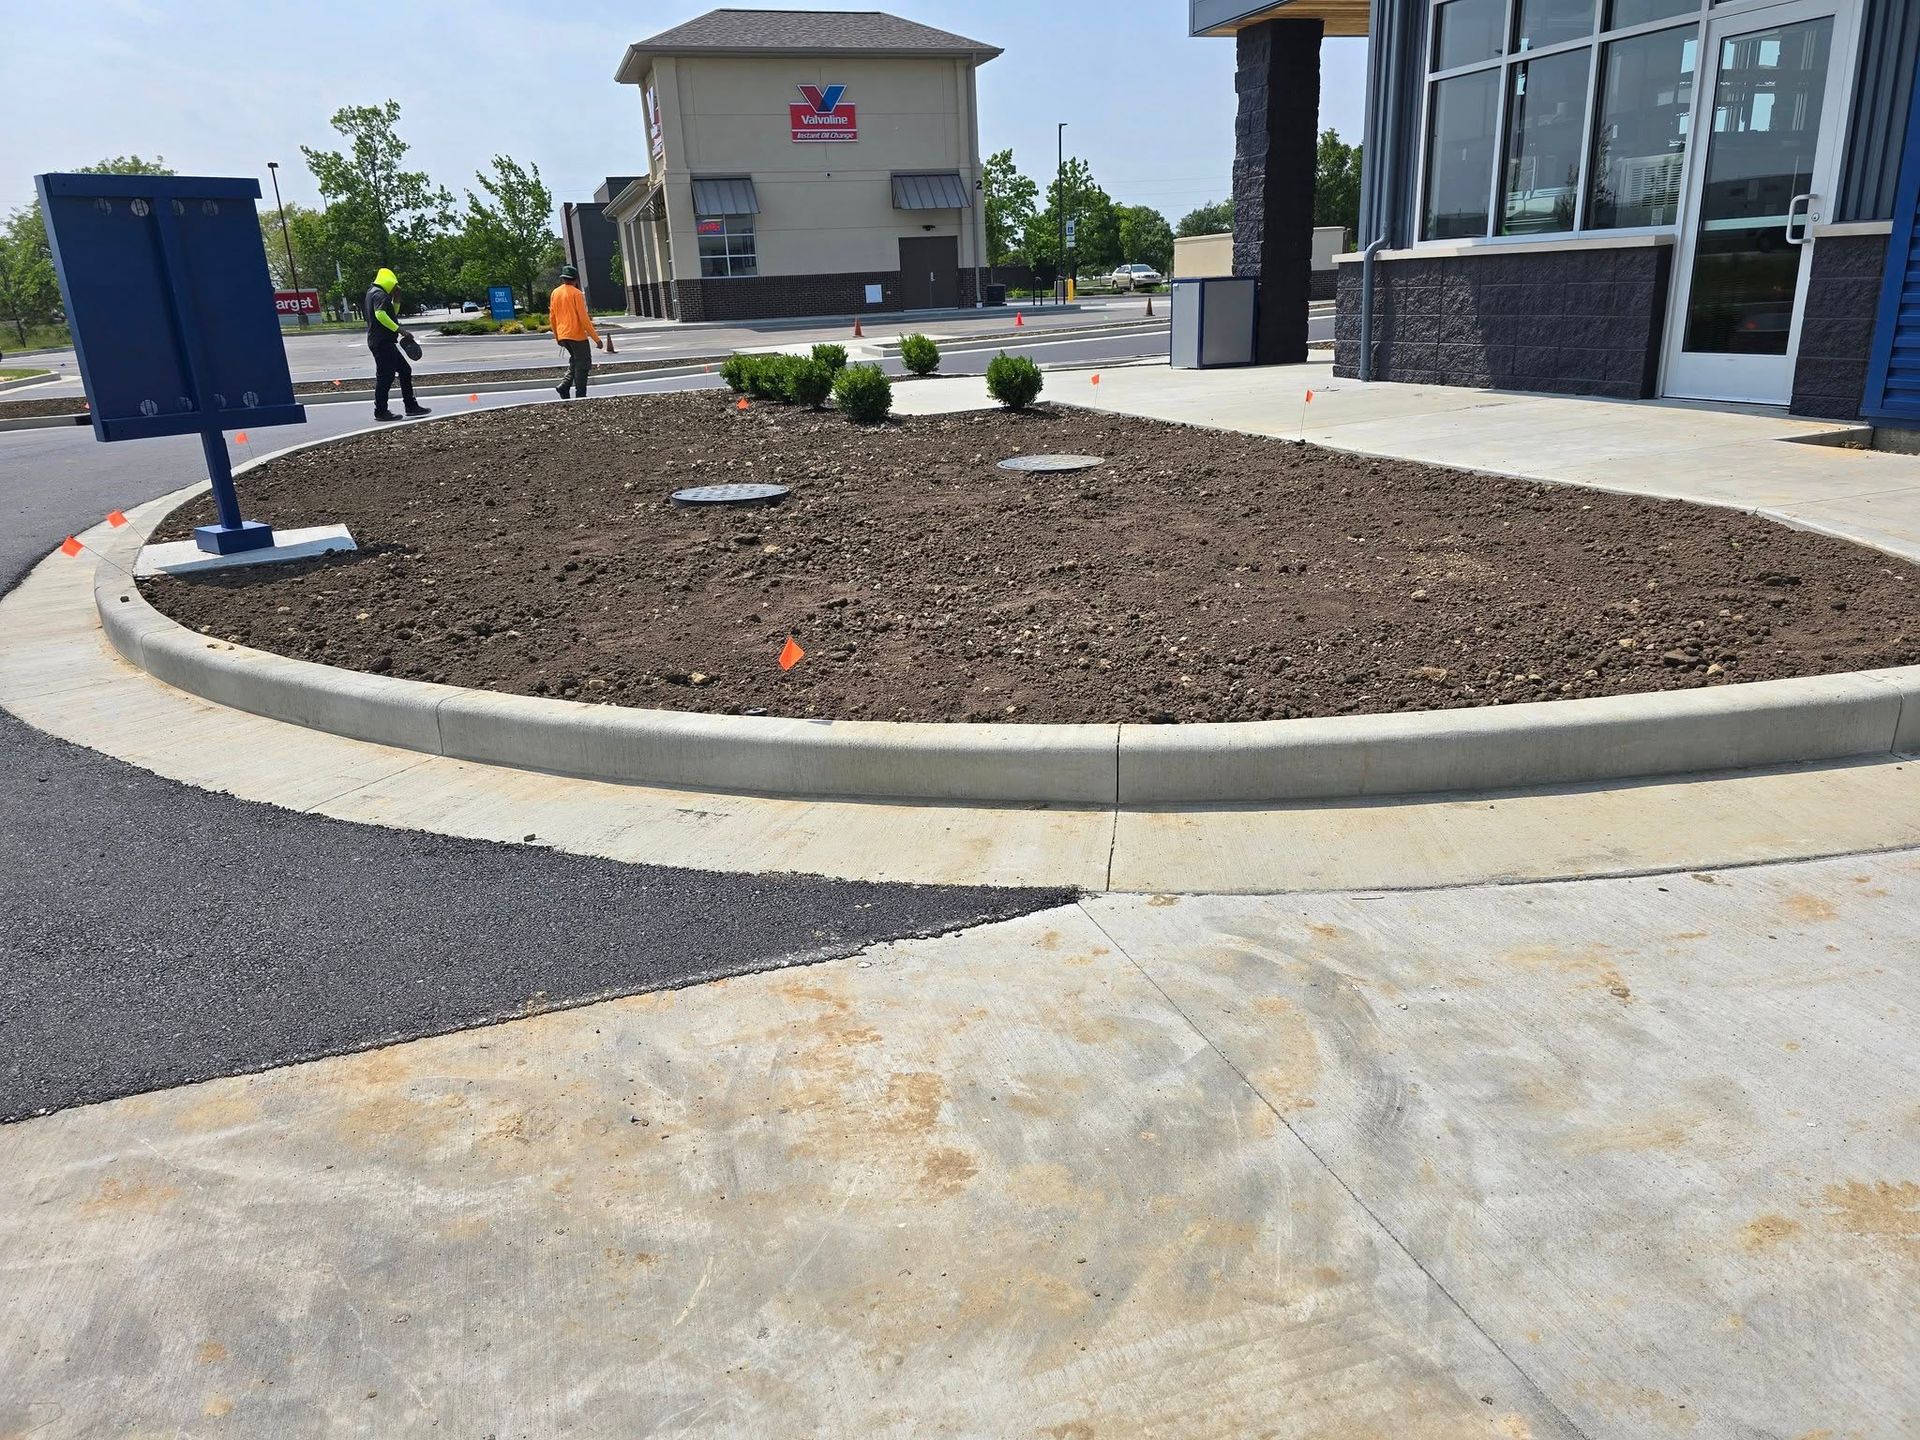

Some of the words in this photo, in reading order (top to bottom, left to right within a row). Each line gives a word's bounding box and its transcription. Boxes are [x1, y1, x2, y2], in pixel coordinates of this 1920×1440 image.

[801, 115, 848, 124] Valvoline
[830, 132, 854, 140] Change
[275, 296, 313, 311] arget
